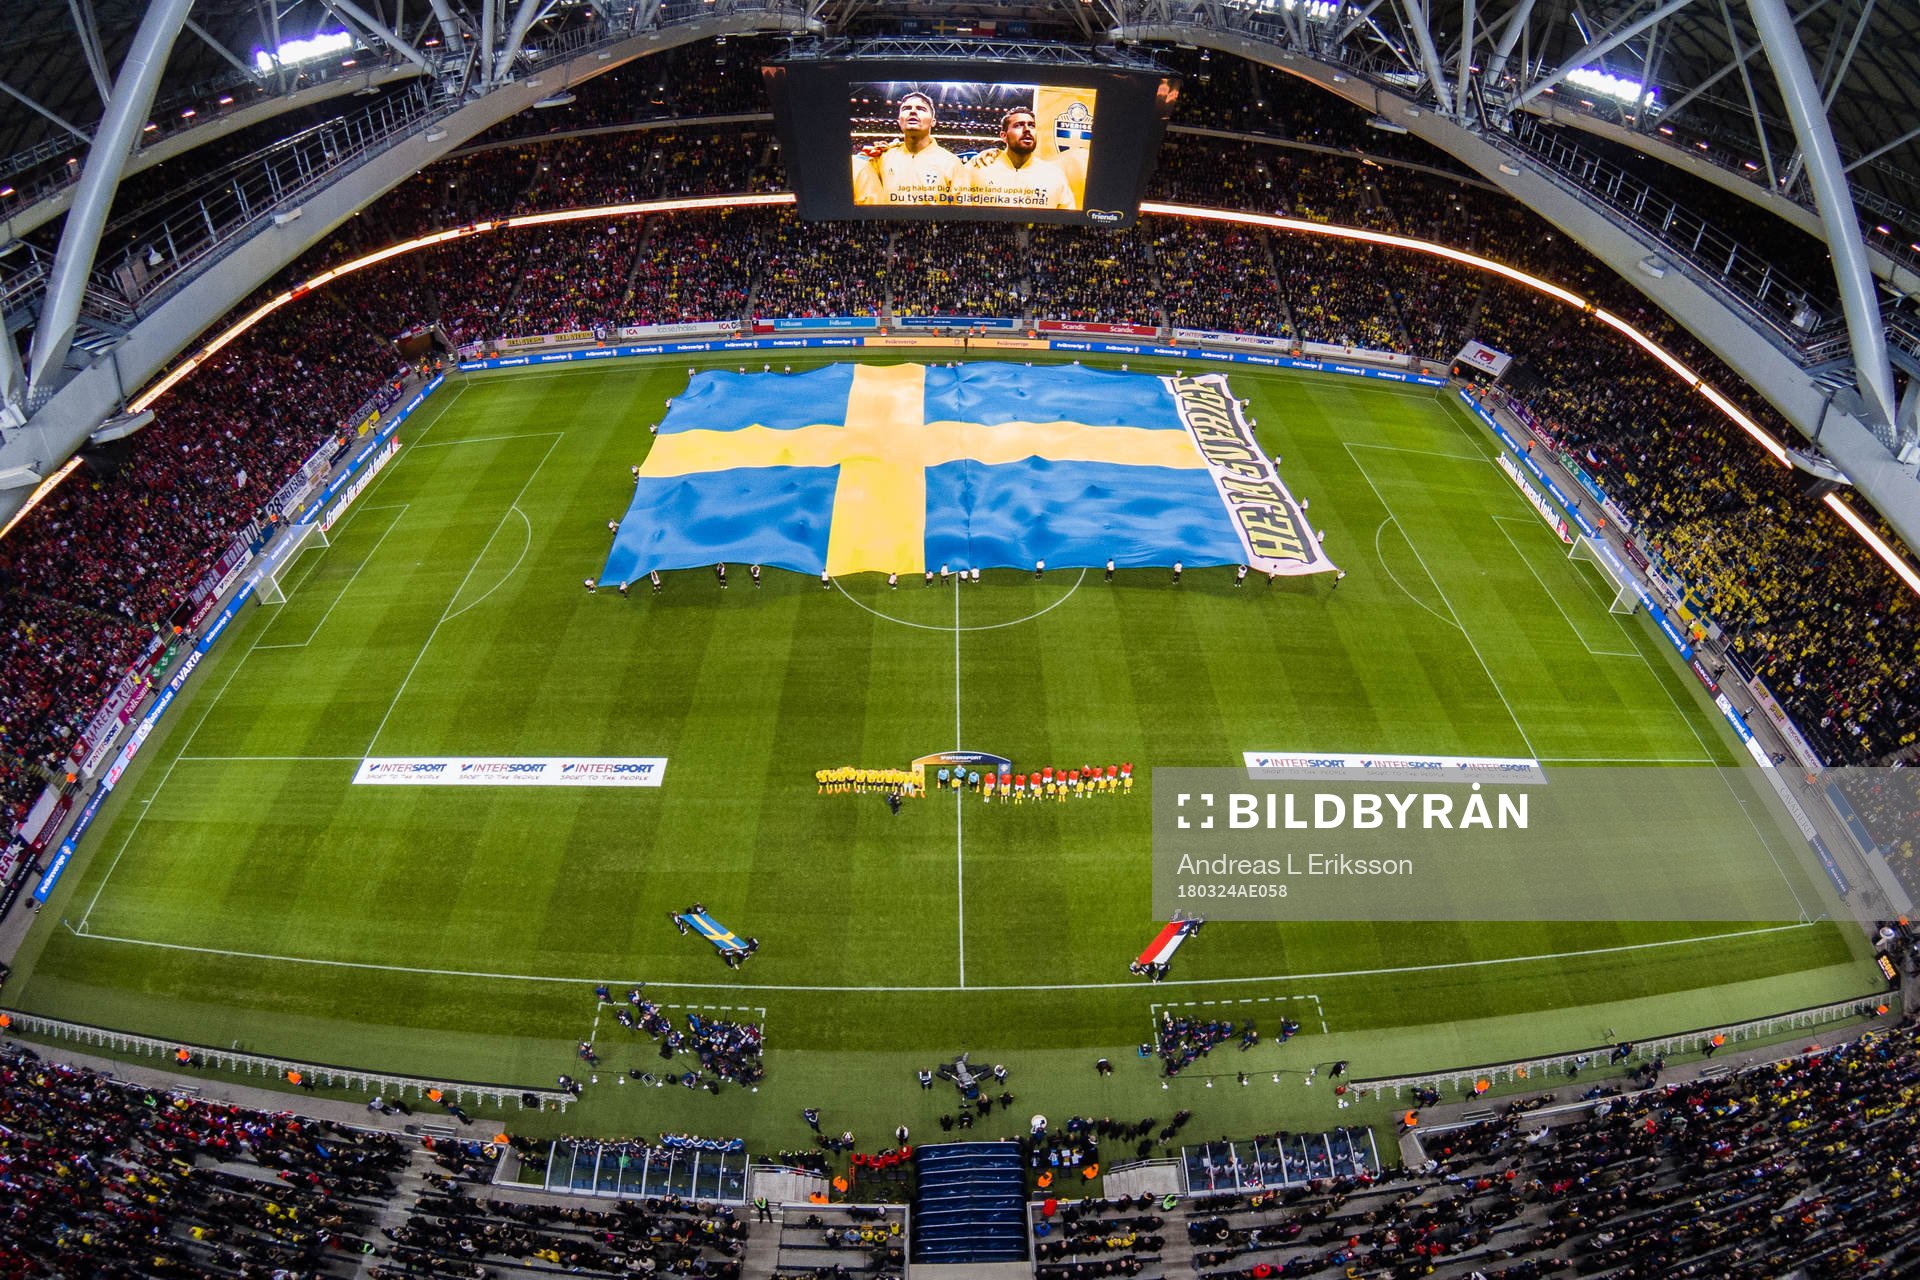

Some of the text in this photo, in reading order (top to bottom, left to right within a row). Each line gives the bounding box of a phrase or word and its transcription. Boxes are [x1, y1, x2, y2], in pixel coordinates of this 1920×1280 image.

[897, 185, 911, 193] Jag
[890, 193, 1049, 205] Du tysta, Du glädjerika sköna!
[1091, 212, 1118, 221] friends
[718, 321, 731, 330] ICA
[1061, 323, 1086, 331] Scandic
[1109, 326, 1135, 334] Scandic
[626, 328, 638, 336] ICA
[1184, 331, 1219, 340] INTERSPORT
[1240, 337, 1275, 345] INTERSPORT
[1534, 425, 1554, 448] Scandic
[1171, 377, 1316, 565] HEJA SVERIGE
[192, 597, 214, 626] Scandic
[178, 650, 203, 681] VARTA
[86, 703, 115, 747] MAREA
[1788, 726, 1802, 746] RICOH
[91, 722, 119, 763] INTERSPORT
[1270, 758, 1345, 768] INTERSPORT
[1804, 749, 1819, 769] RICOH
[380, 763, 447, 773] INTERSPORT
[473, 763, 547, 773] INTERSPORT
[575, 763, 655, 773] INTERSPORT
[1374, 760, 1442, 770] INTERSPORT
[1468, 763, 1531, 772] INTERSPORT
[1780, 787, 1812, 837] CAVALIERE
[1880, 955, 1896, 978] SCORE
